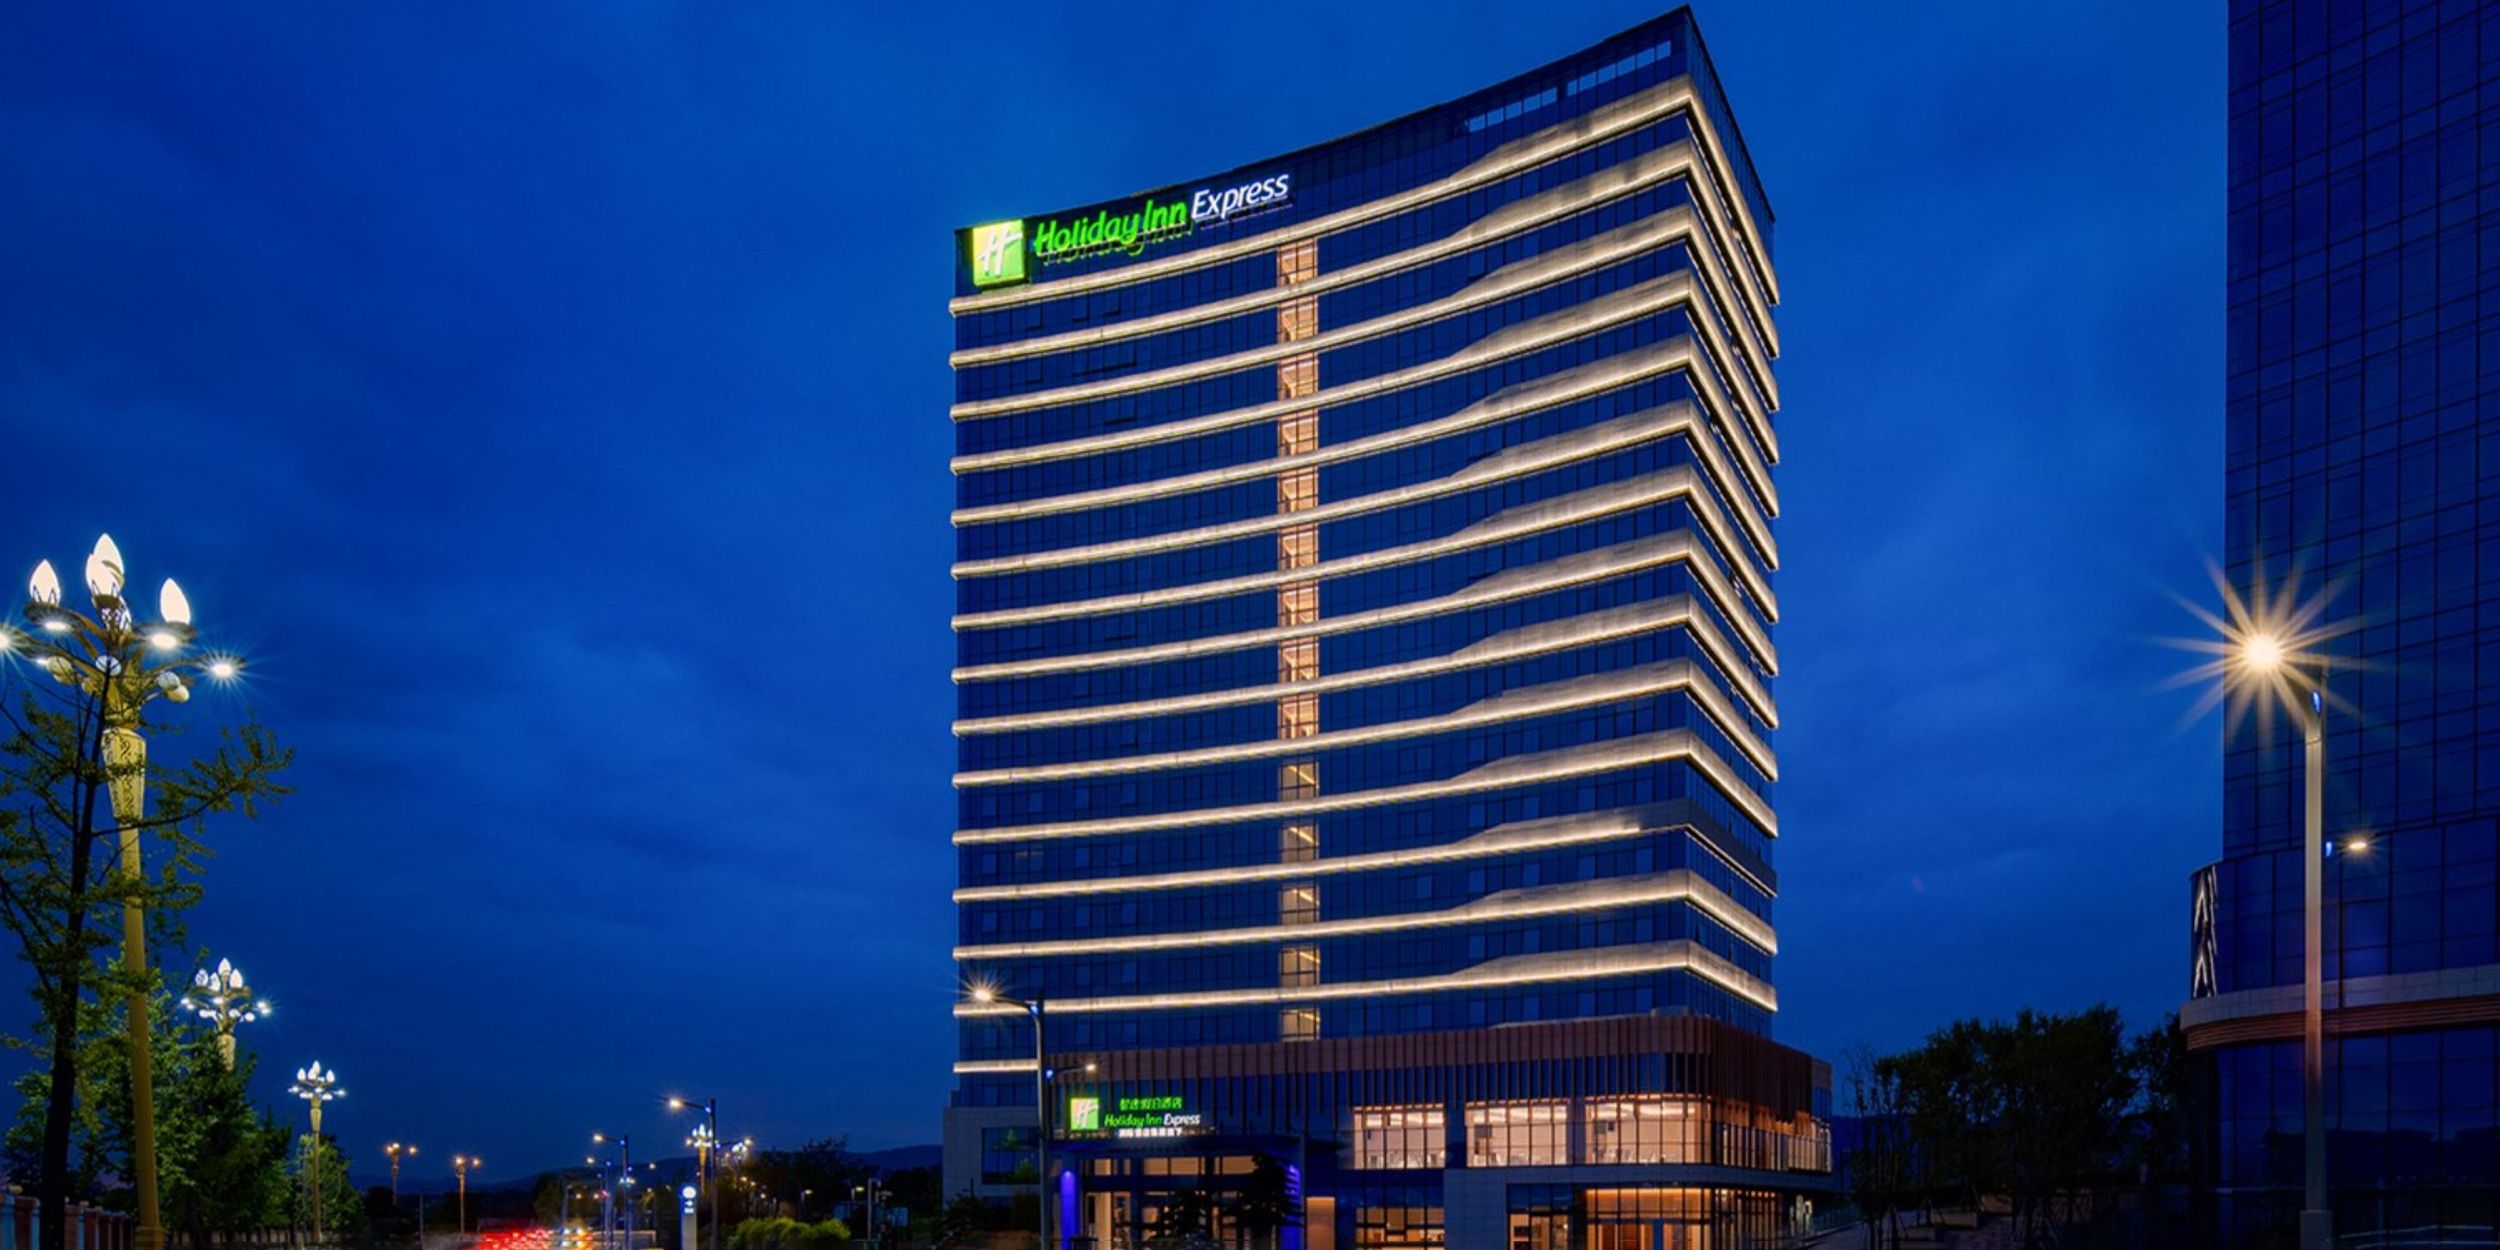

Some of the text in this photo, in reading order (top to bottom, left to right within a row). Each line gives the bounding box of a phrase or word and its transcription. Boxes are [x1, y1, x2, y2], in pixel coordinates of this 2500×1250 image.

[1034, 175, 1289, 256] Holiday Inn Express
[1104, 1113, 1200, 1128] Holiday Inn Express
